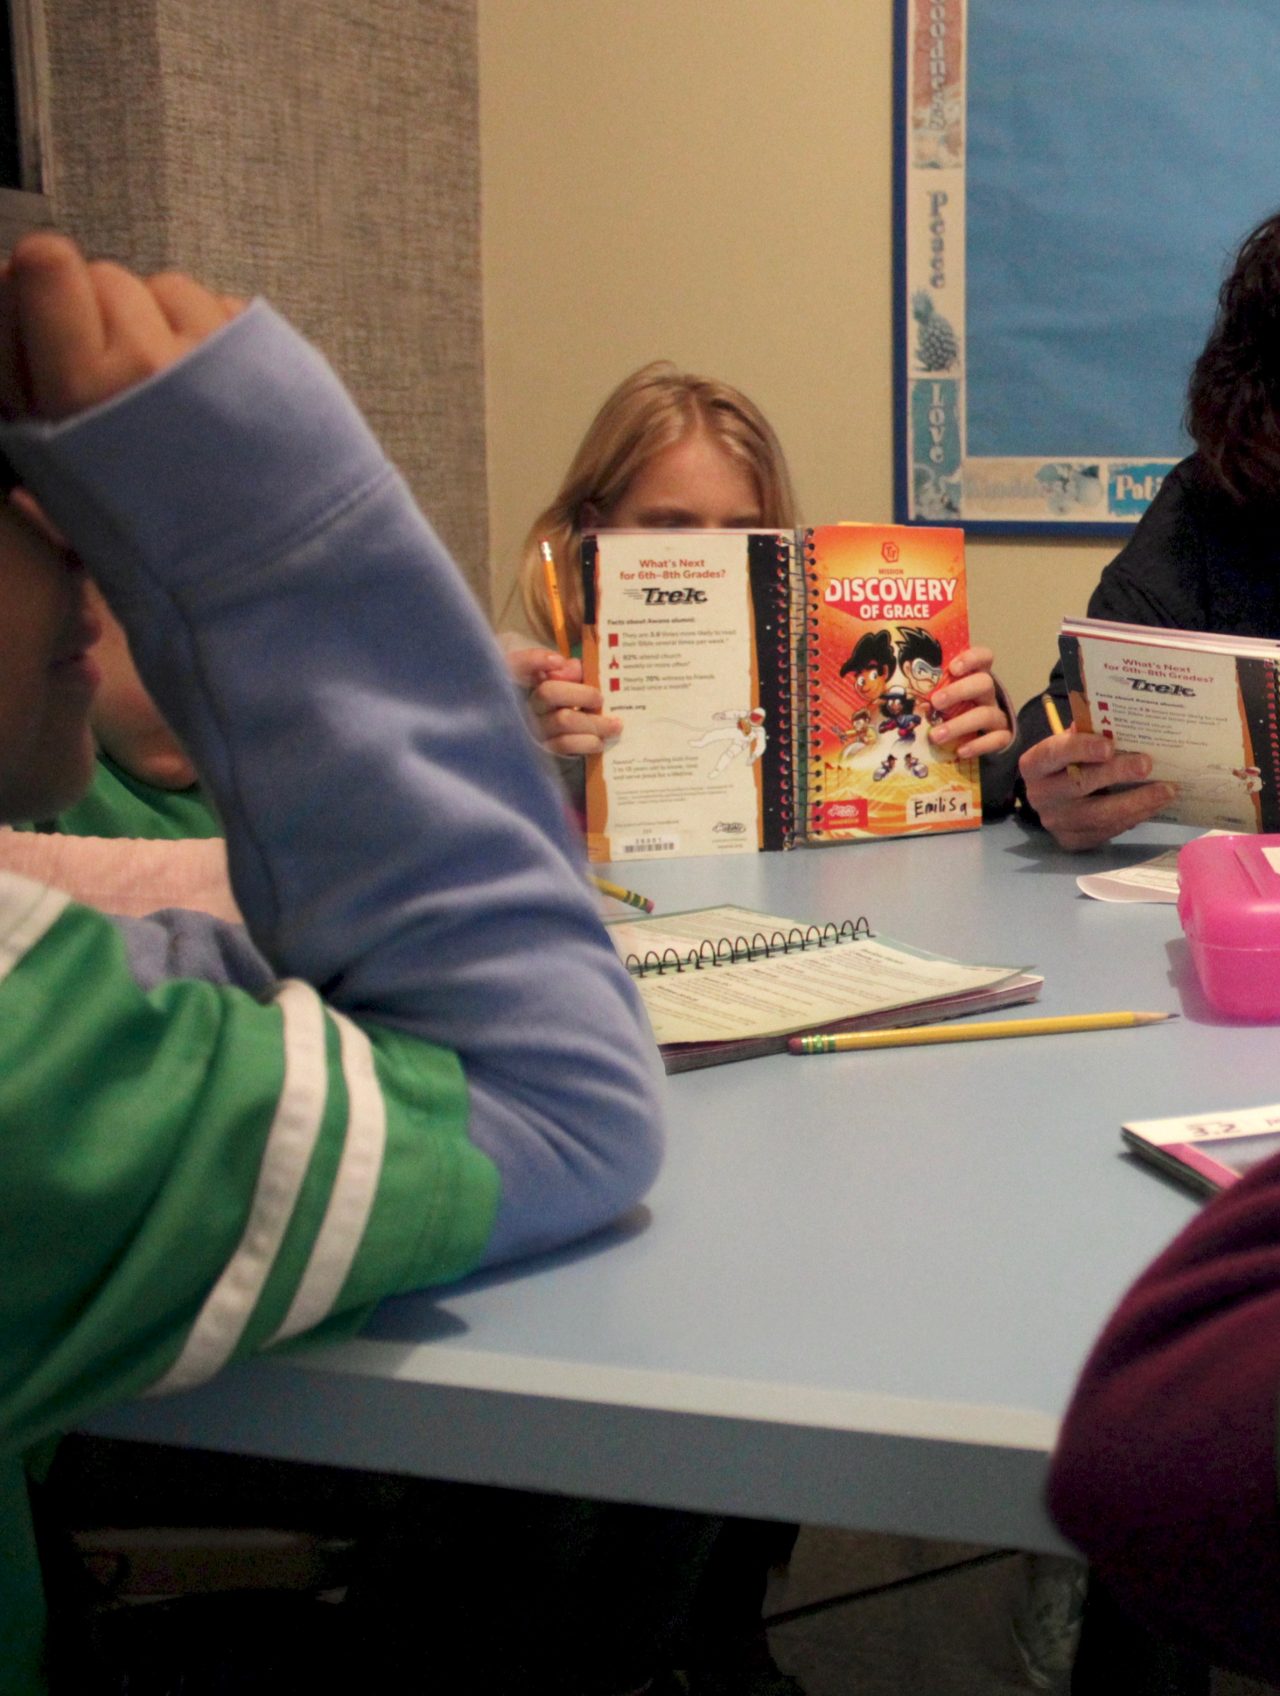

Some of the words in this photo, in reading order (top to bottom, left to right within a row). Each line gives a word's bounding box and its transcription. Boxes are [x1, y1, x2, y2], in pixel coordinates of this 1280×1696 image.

[929, 0, 947, 130] oodness
[927, 190, 948, 290] Peace
[927, 382, 946, 464] Love
[620, 570, 636, 580] for
[682, 568, 726, 580] Grades?
[639, 559, 677, 569] What's
[679, 558, 705, 568] Next
[641, 588, 707, 605] Trek
[824, 578, 957, 602] DISCOVERY
[859, 605, 880, 619] OF
[882, 603, 930, 619] GRACE
[1103, 662, 1120, 672] for
[1169, 670, 1214, 684] Grades?
[1122, 657, 1161, 670] What's
[1163, 662, 1191, 673] Next
[1126, 677, 1197, 698] Trek
